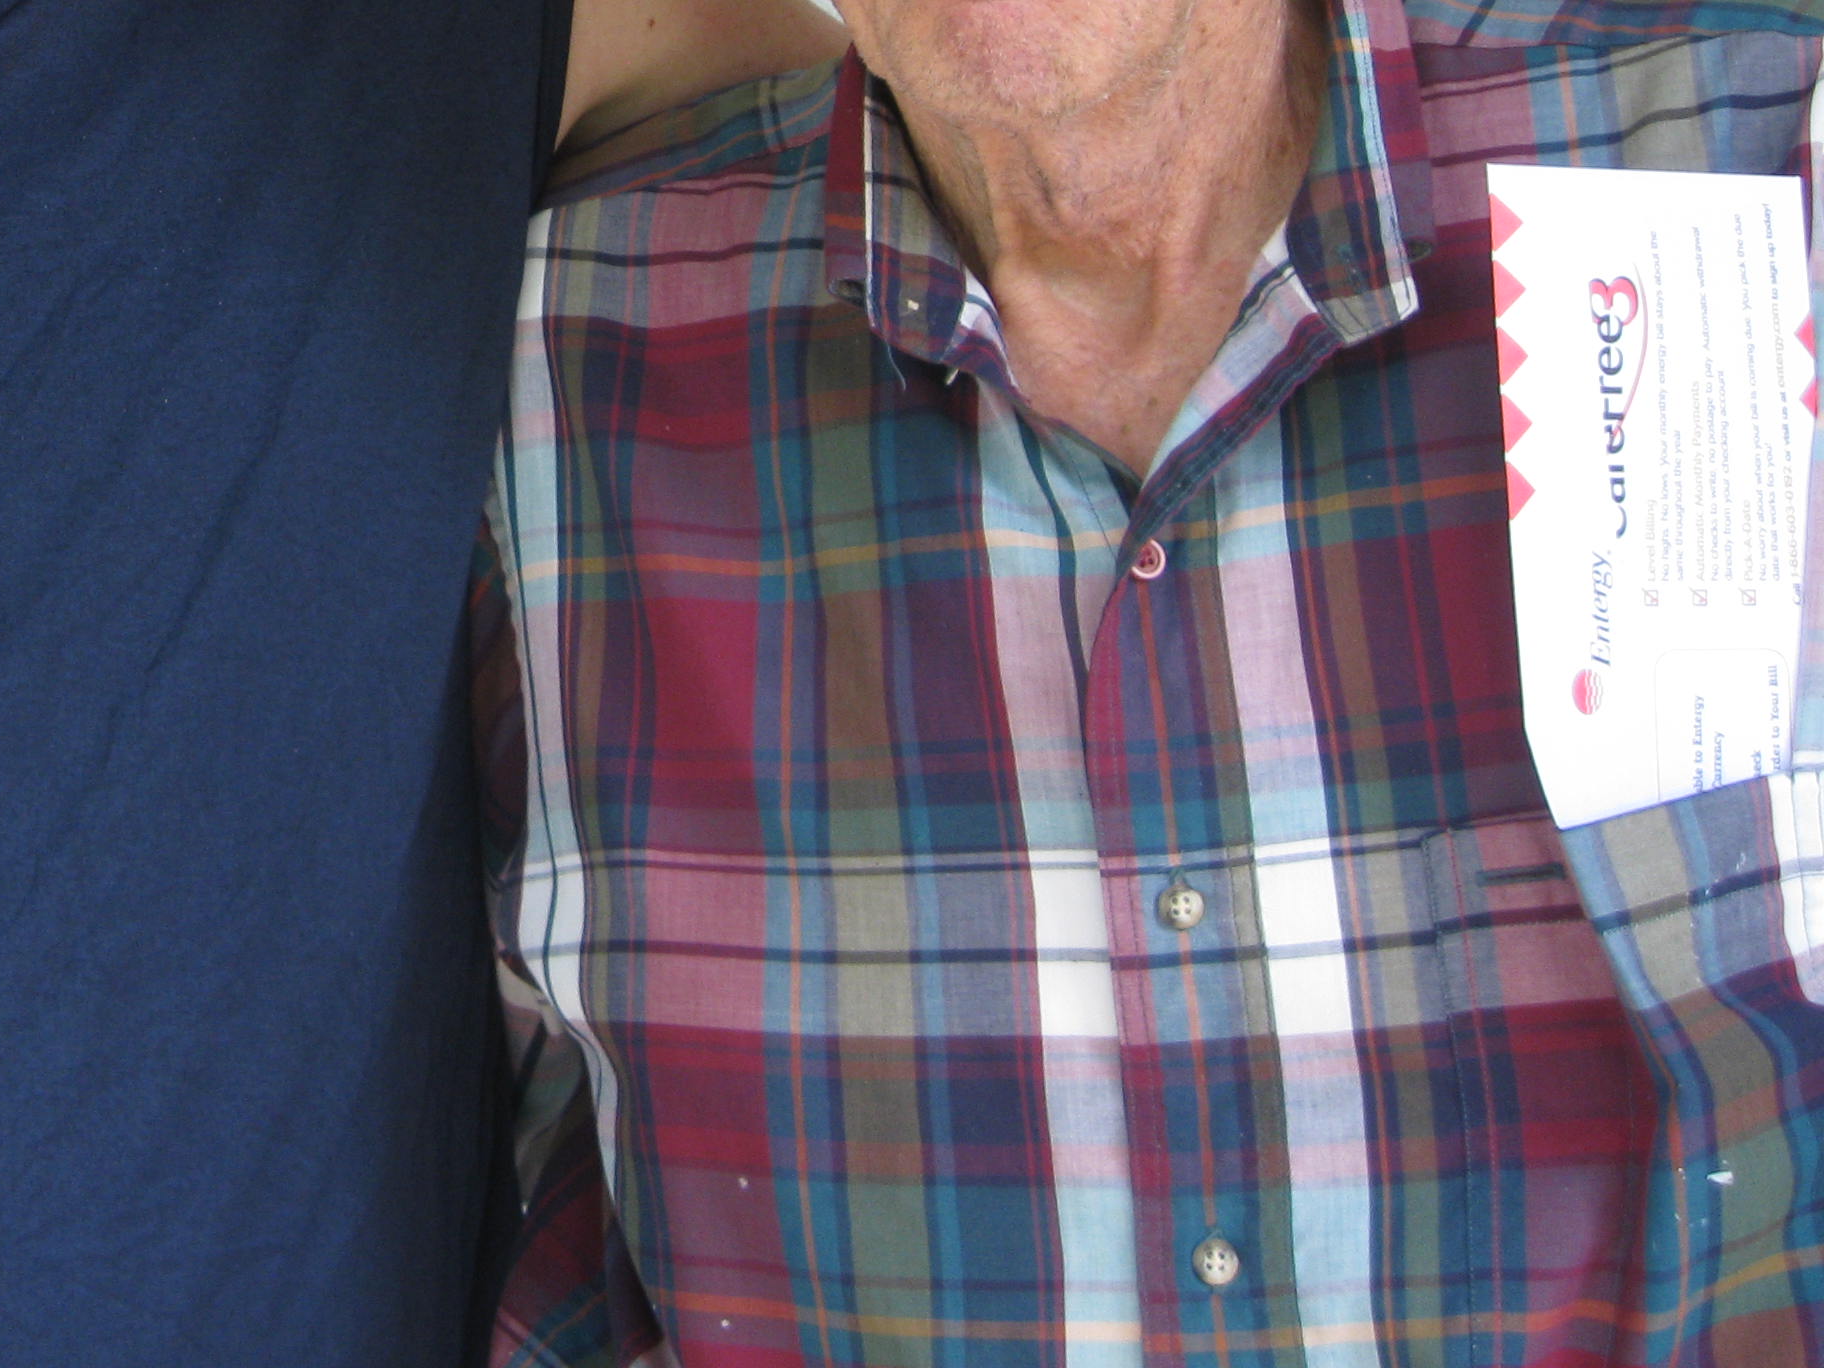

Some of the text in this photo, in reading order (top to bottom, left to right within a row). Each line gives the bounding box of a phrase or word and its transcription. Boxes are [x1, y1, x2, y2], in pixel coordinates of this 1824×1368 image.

[1735, 240, 1744, 258] the
[1767, 243, 1776, 257] up
[1652, 254, 1662, 285] about
[1737, 262, 1748, 285] pick
[1740, 288, 1752, 310] You
[1700, 294, 1710, 351] Automatic
[1745, 344, 1756, 386] coming
[1658, 389, 1667, 435] monthly
[1691, 381, 1702, 446] Payments
[1705, 398, 1716, 444] postage
[1719, 421, 1730, 473] checking
[1751, 424, 1761, 449] your
[1658, 440, 1670, 466] Your
[1693, 452, 1704, 506] Monthly
[1722, 479, 1732, 503] your
[1645, 499, 1657, 582] Level Billing
[1710, 564, 1719, 581] No
[1724, 540, 1733, 581] directly
[1792, 583, 1802, 605] Call
[1590, 550, 1613, 667] Entergy
[1768, 665, 1778, 686] Bill
[1770, 693, 1779, 720] Your
[1692, 696, 1704, 746] Entergy
[1770, 726, 1780, 738] to
[1694, 751, 1703, 763] to
